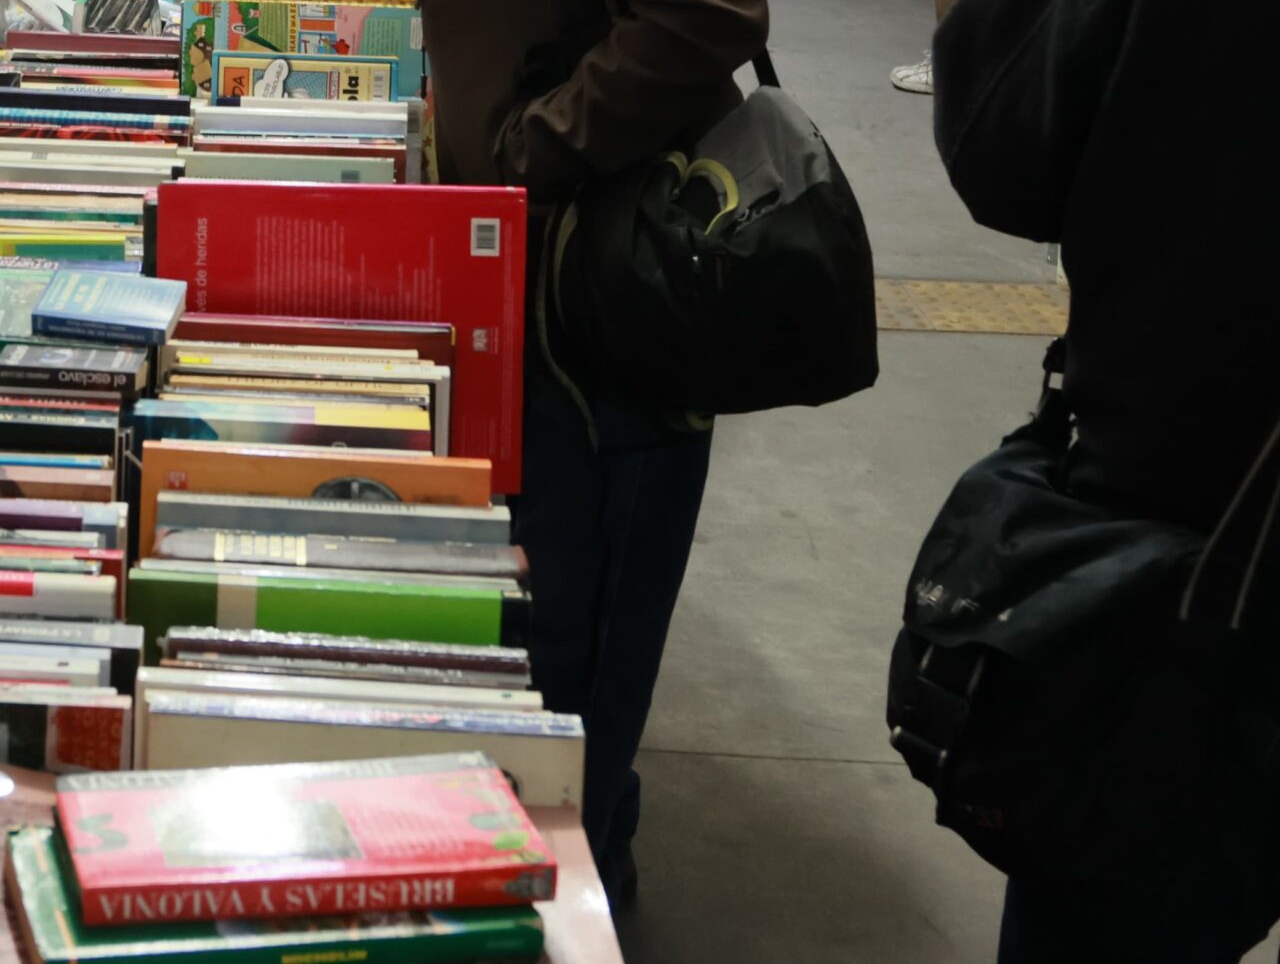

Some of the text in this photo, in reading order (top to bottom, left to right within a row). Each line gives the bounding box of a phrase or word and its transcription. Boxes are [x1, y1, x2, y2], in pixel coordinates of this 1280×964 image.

[231, 75, 246, 96] DA
[194, 217, 208, 312] vés de heridas
[58, 370, 127, 388] el esclavo
[98, 877, 456, 921] BRUSELAS Y VALONIA
